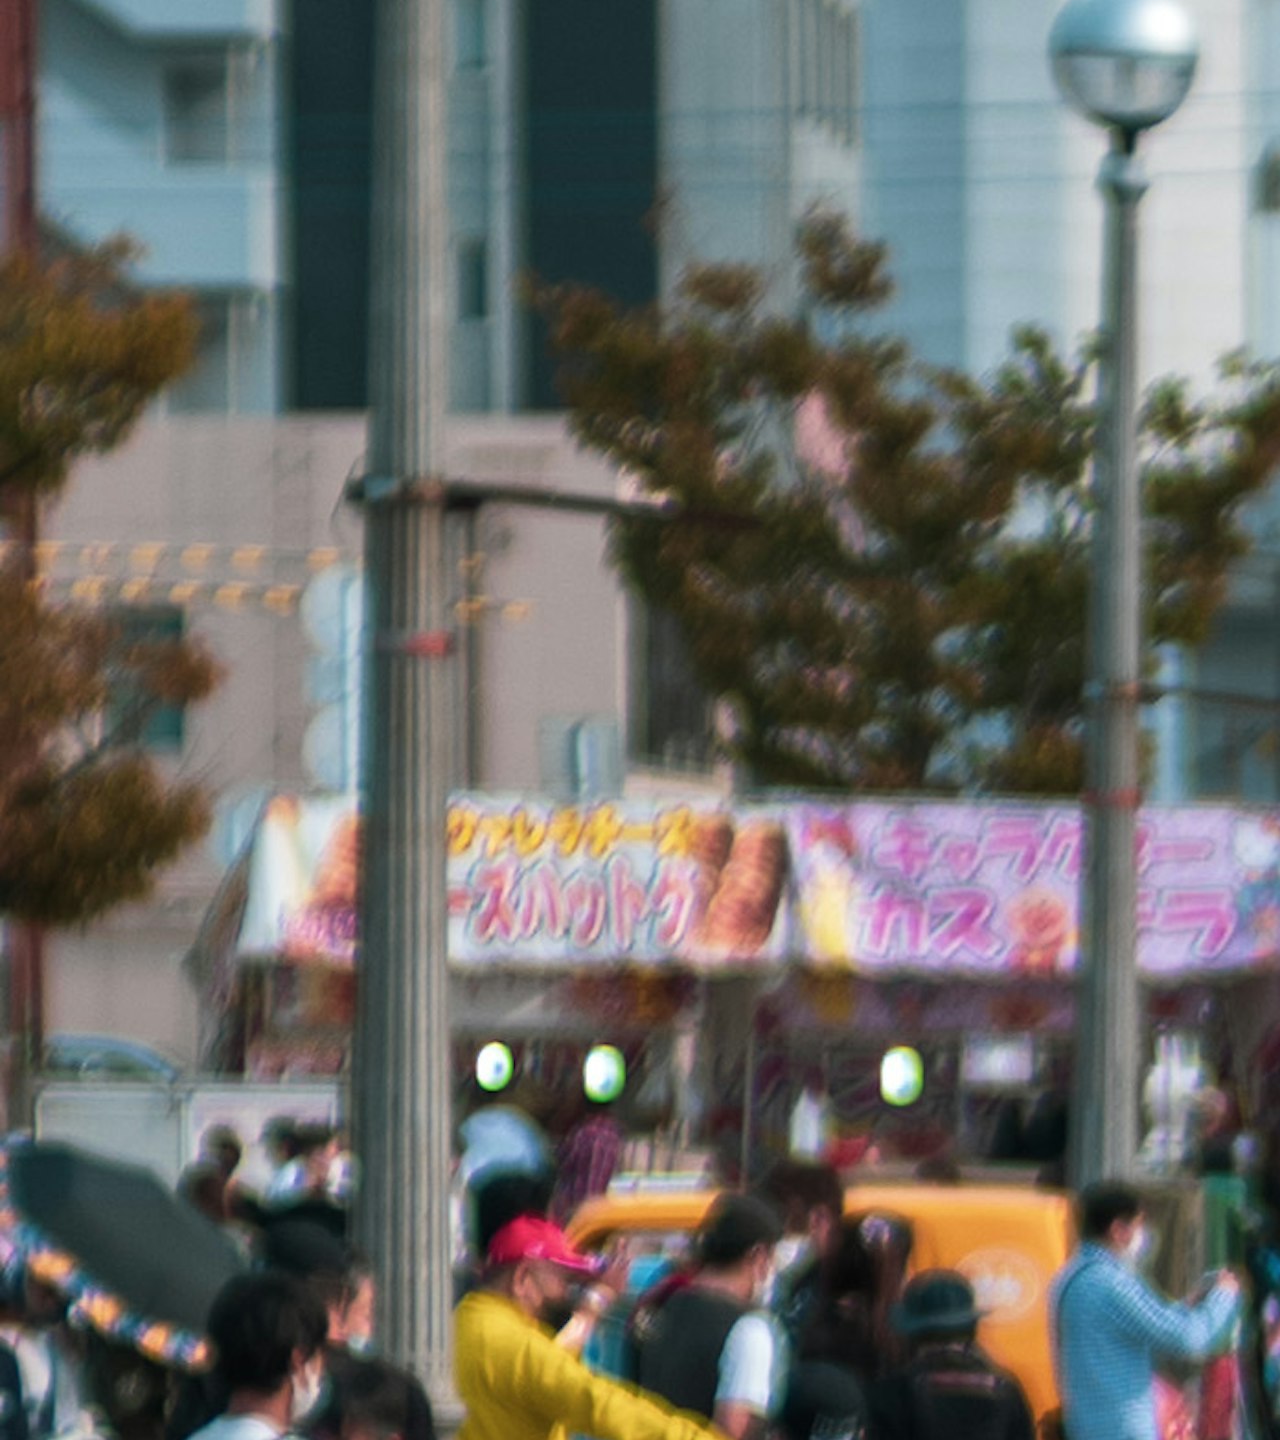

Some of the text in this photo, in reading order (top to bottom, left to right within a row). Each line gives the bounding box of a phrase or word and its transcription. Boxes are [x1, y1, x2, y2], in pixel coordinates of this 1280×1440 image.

[872, 813, 1214, 883] キャラクー
[858, 884, 1239, 957] カスラ
